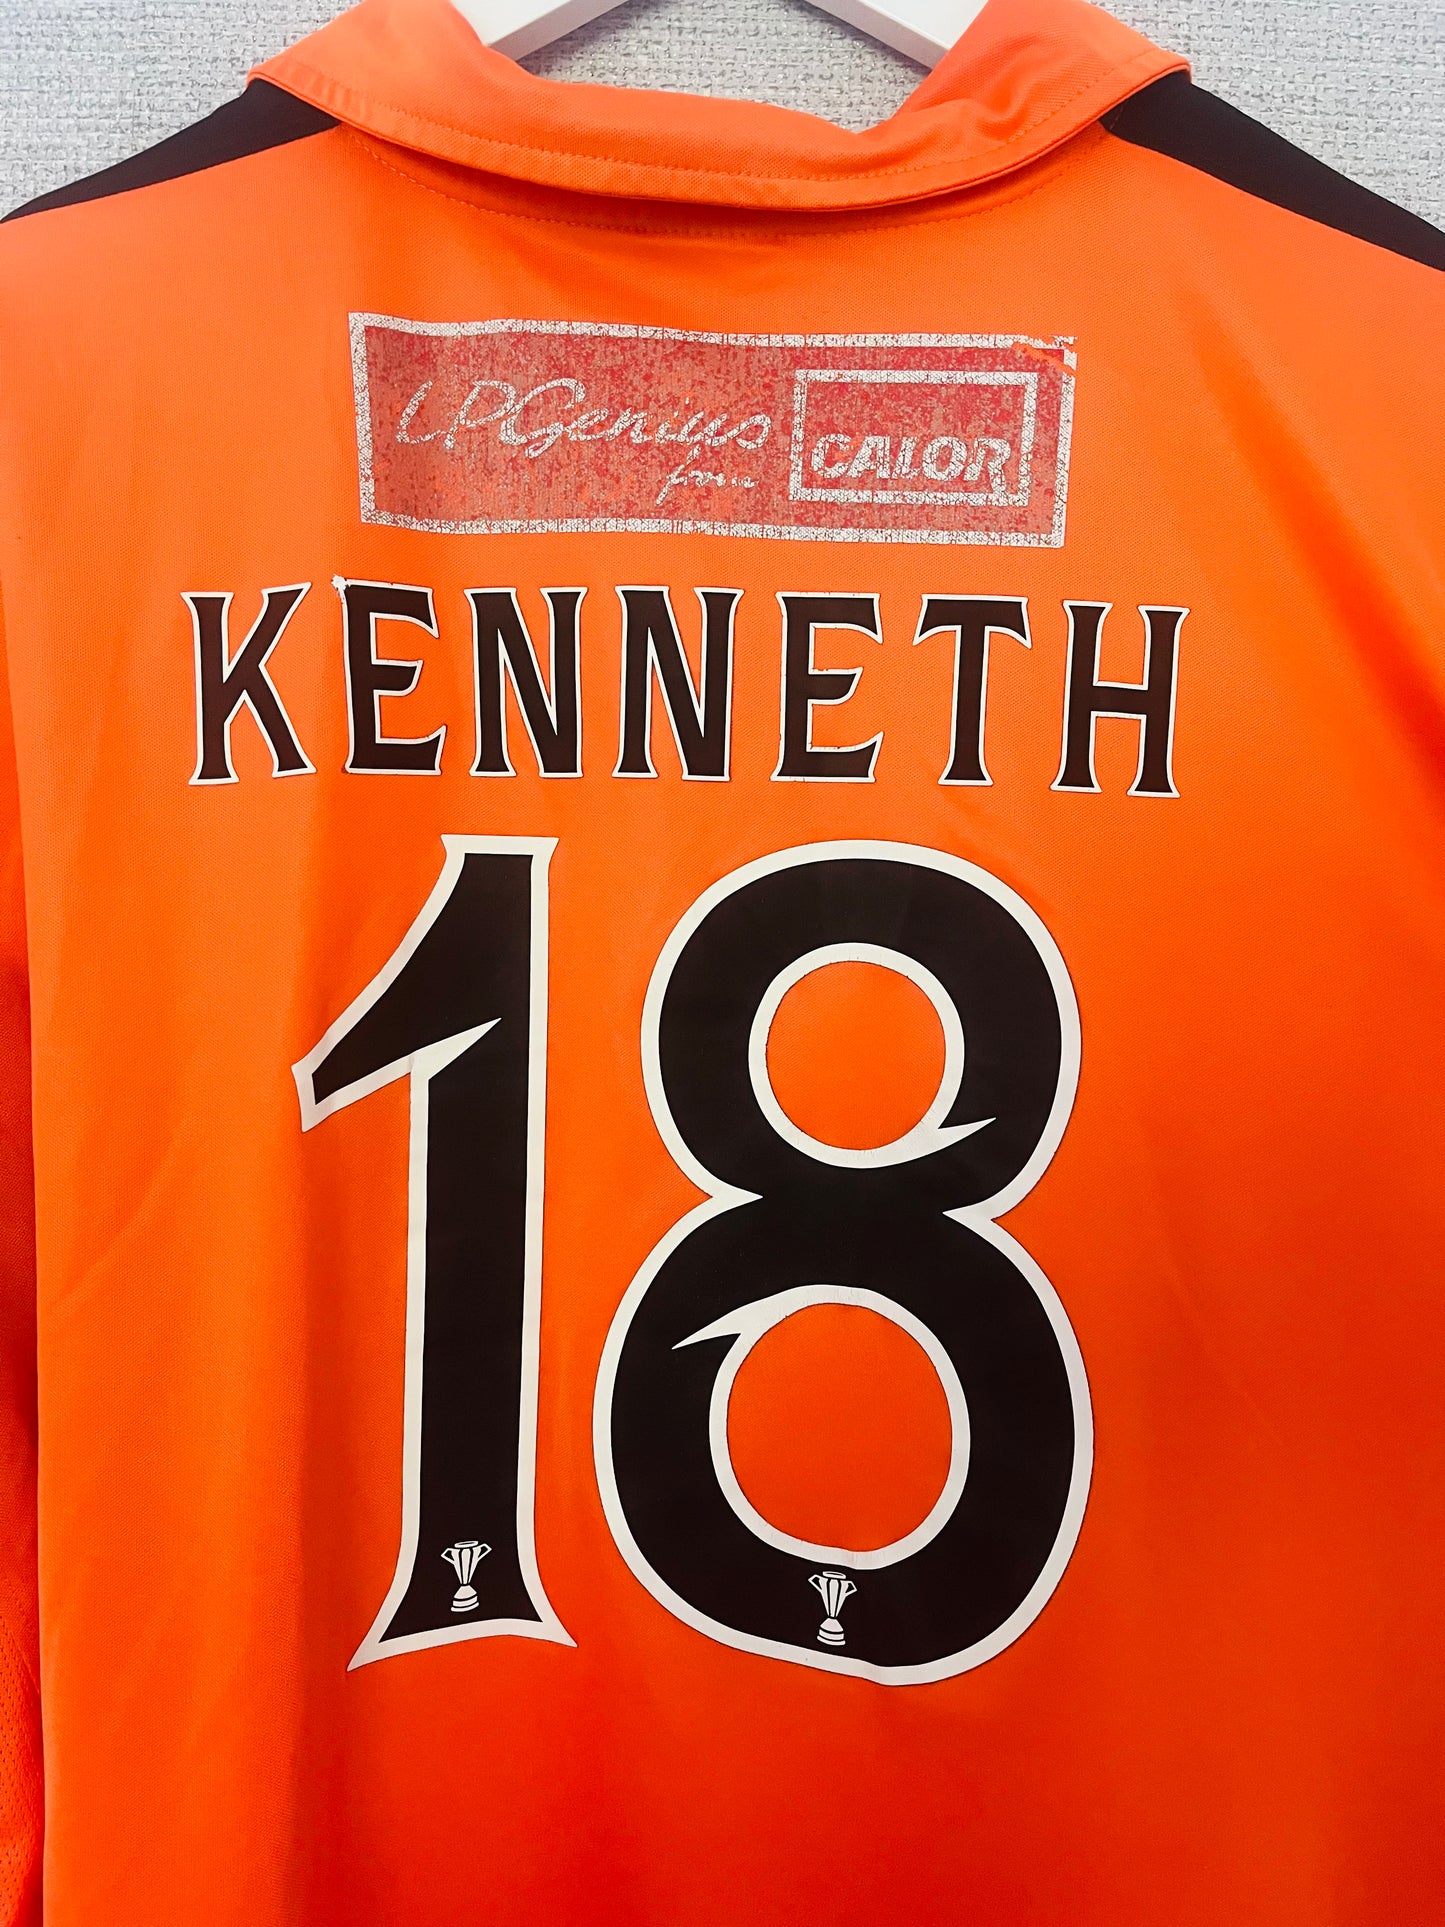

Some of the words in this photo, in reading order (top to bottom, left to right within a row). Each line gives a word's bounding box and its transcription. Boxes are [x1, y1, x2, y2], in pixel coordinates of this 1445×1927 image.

[809, 433, 1013, 493] CALOR
[181, 577, 1191, 799] KENNETH
[291, 834, 1095, 1686] 18
